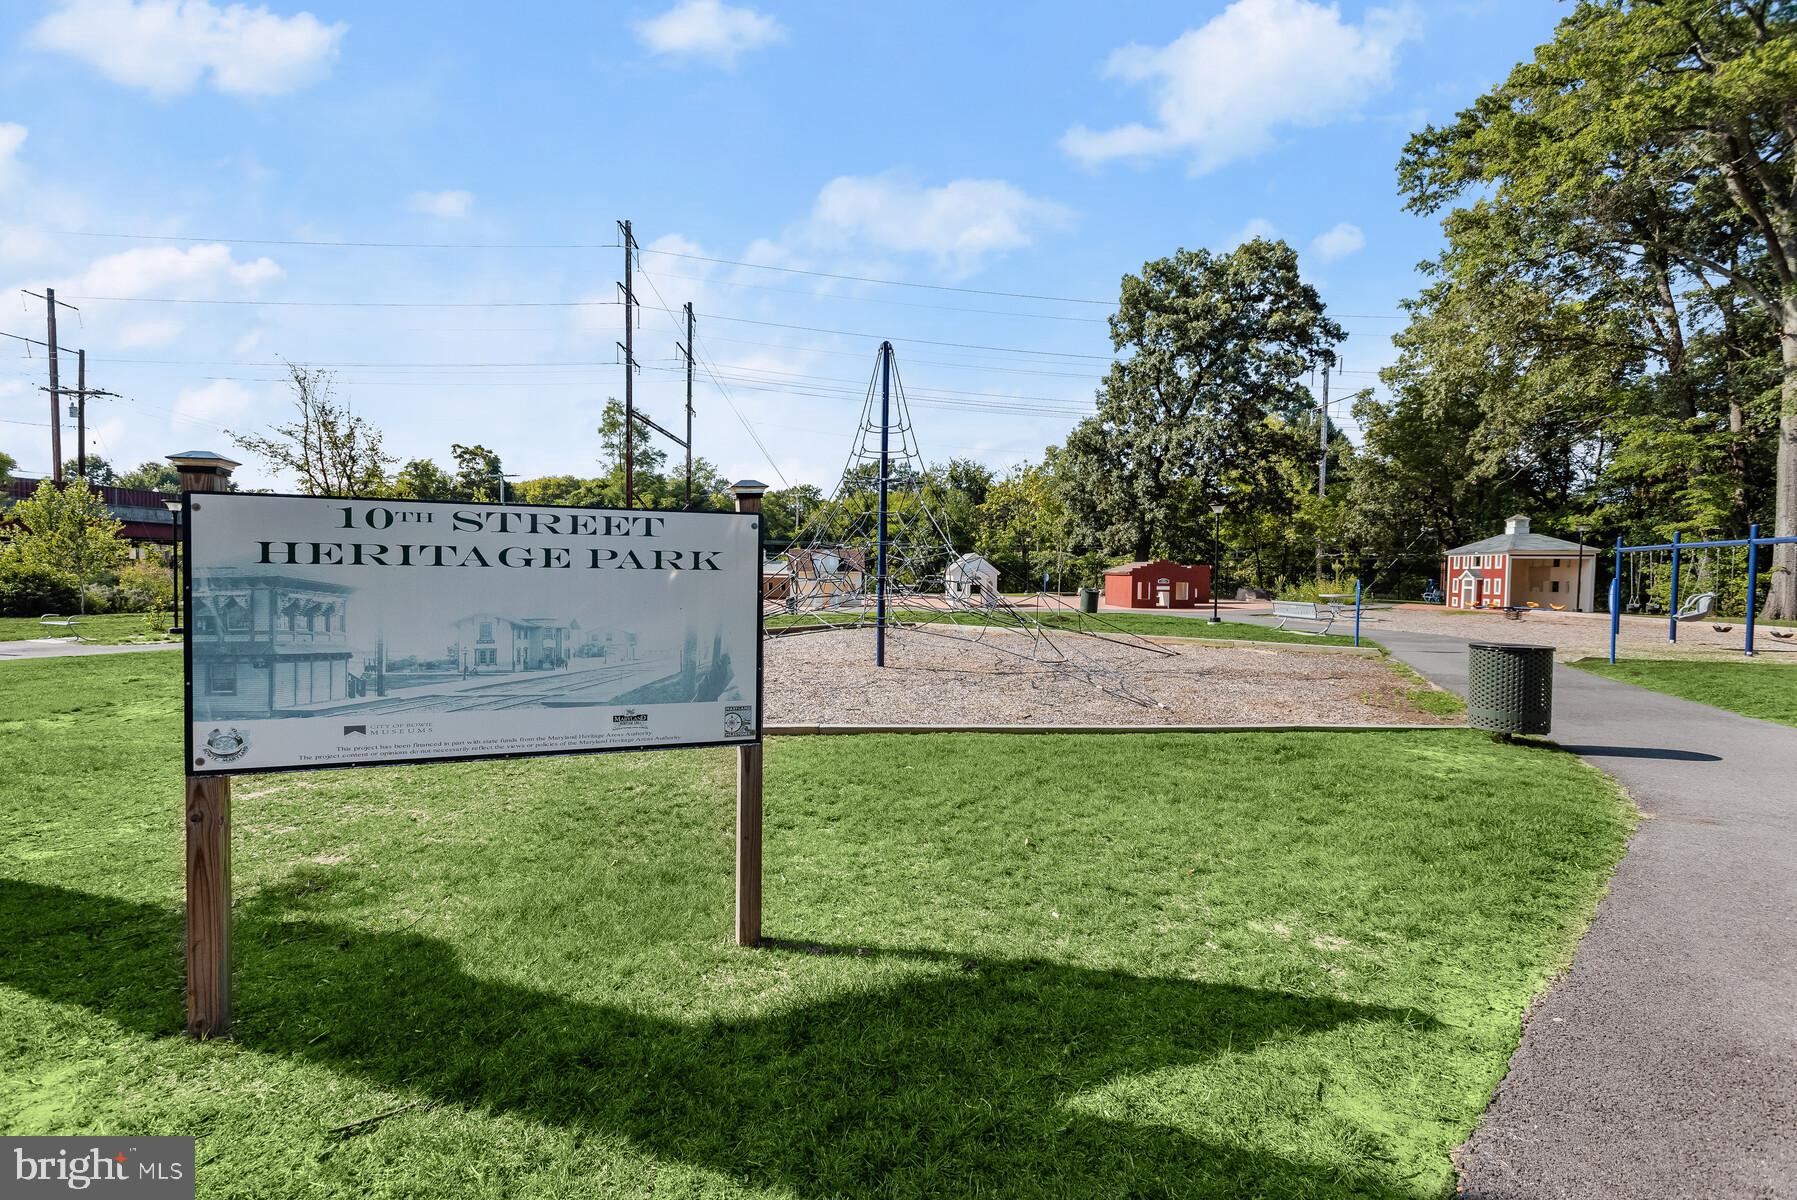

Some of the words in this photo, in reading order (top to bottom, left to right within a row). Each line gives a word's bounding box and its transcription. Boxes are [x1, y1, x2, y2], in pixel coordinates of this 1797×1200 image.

[452, 510, 665, 537] STREET
[255, 541, 571, 568] HERITAGE
[586, 548, 724, 571] PARK
[370, 728, 433, 736] MUSEUMS
[353, 744, 378, 752] project
[315, 753, 340, 761] project
